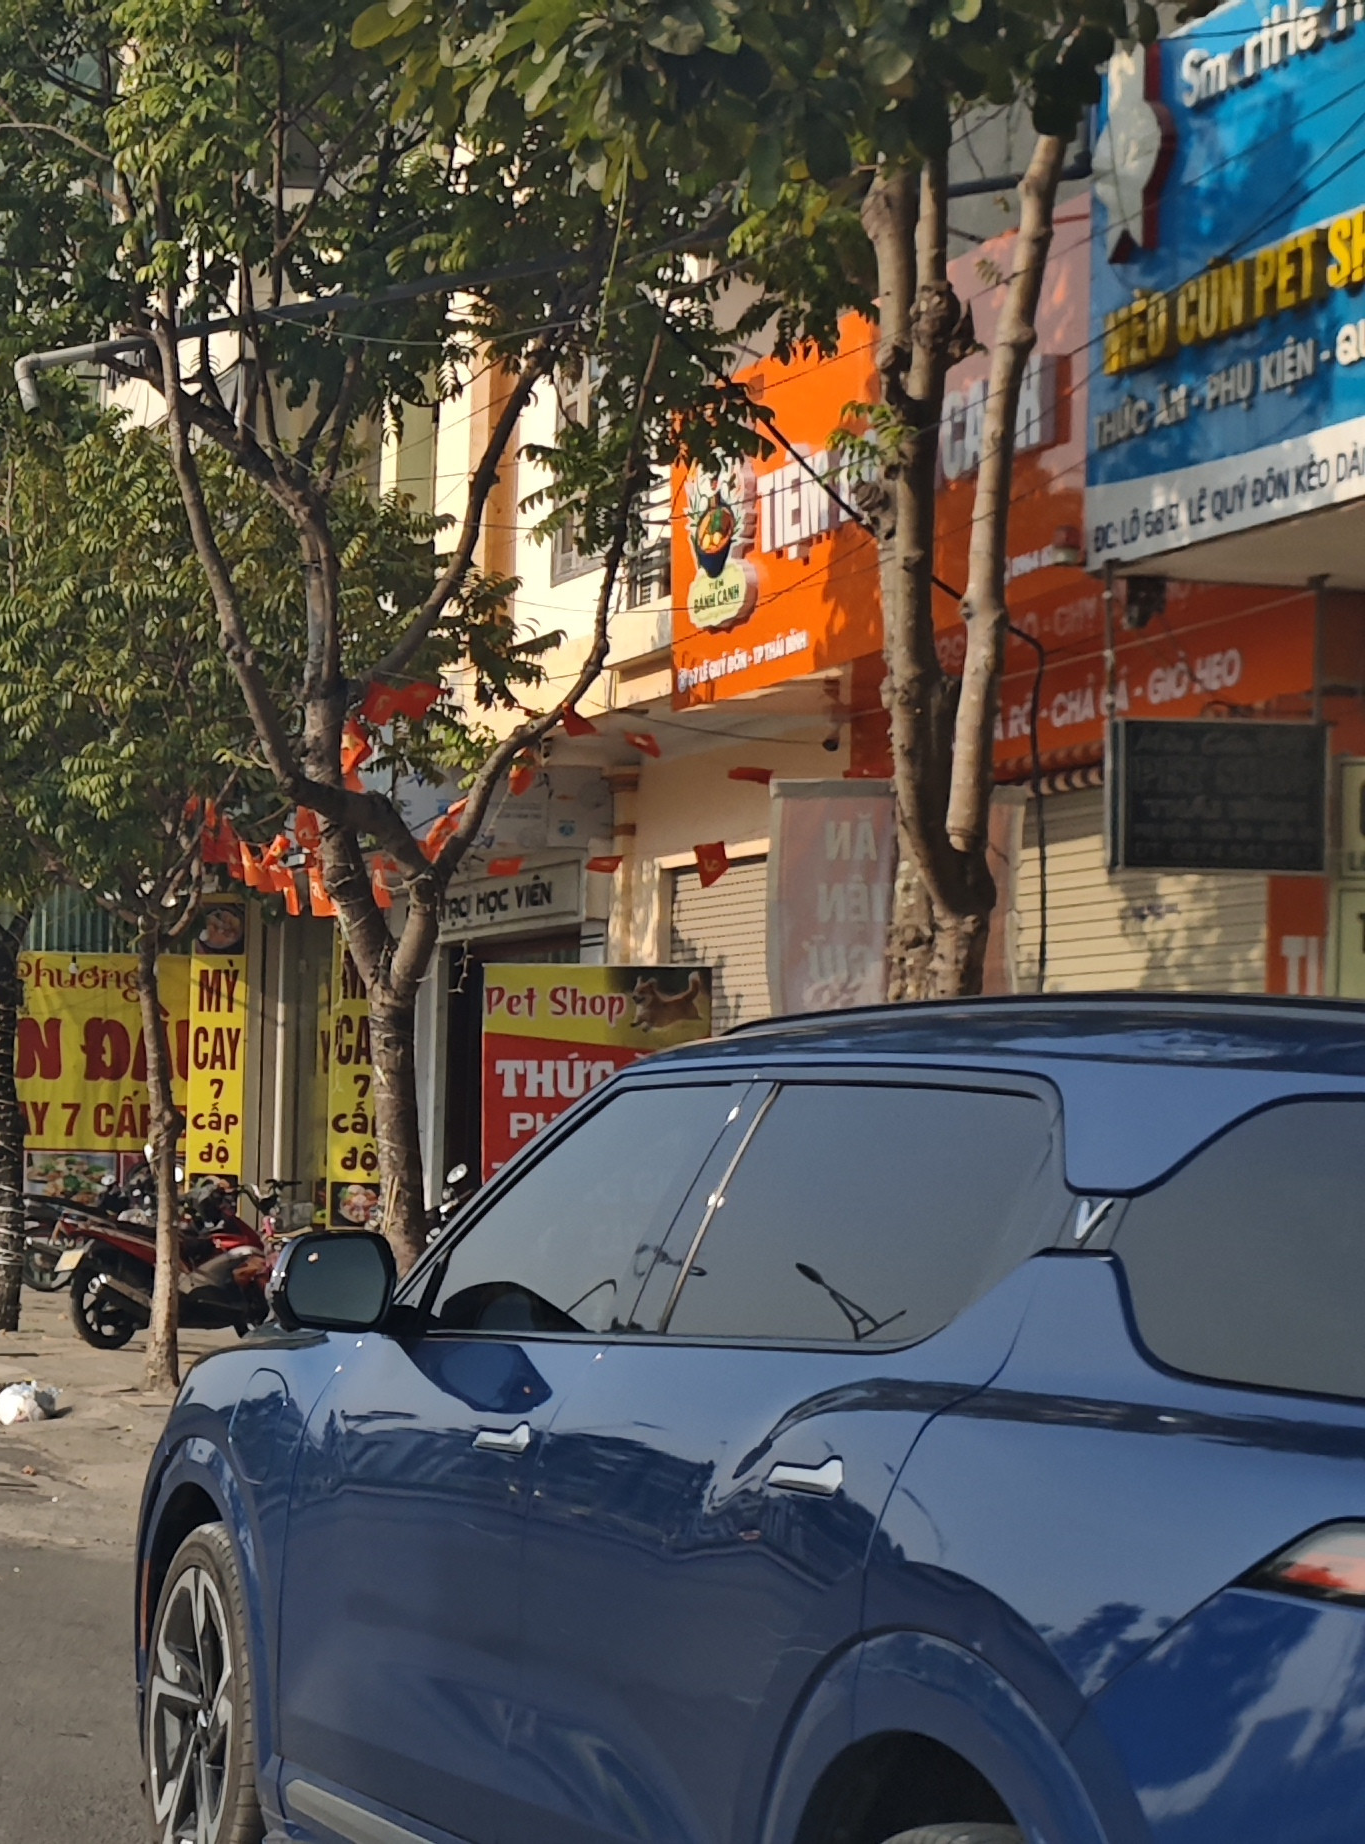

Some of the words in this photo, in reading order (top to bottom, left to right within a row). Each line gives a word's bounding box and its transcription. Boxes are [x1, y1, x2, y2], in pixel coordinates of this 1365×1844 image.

[1254, 229, 1318, 318] PET
[1206, 358, 1254, 411] PHỤ
[1260, 335, 1316, 395] KIỆN
[757, 443, 831, 560] TIỆM
[476, 887, 509, 921] HỌC
[515, 874, 553, 909] VIÊN
[198, 959, 239, 1013] MỲ
[485, 986, 537, 1017] Pet
[549, 985, 625, 1025] Shop
[193, 1026, 241, 1071] CAY
[336, 1014, 371, 1066] CA
[210, 1078, 224, 1099] 7
[353, 1074, 371, 1098] 7
[61, 1103, 81, 1137] 7
[191, 1101, 239, 1135] cấp
[199, 1139, 229, 1169] độ
